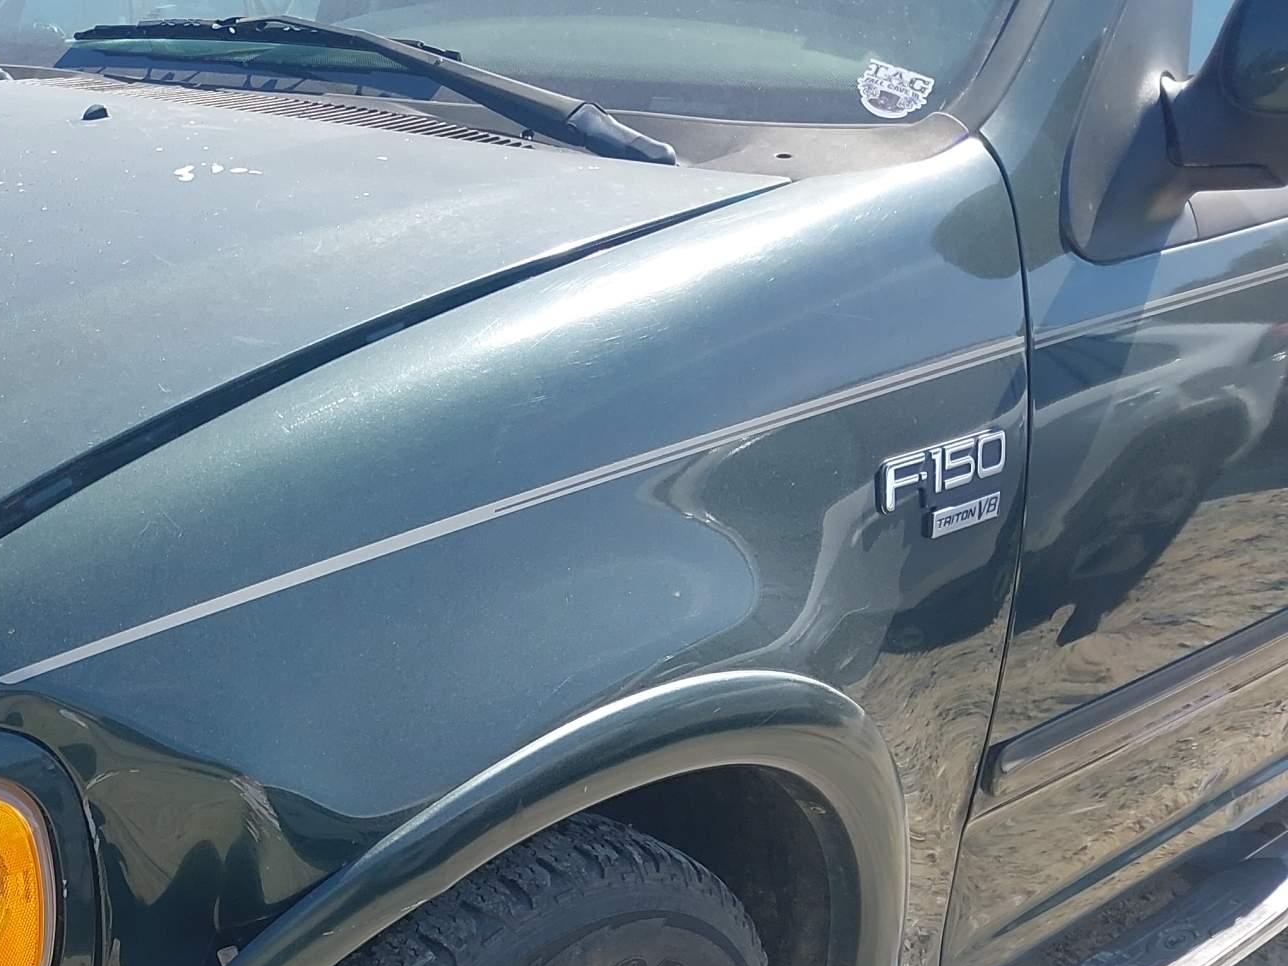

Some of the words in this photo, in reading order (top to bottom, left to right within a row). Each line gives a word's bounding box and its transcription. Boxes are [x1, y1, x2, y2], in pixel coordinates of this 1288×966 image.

[885, 430, 1007, 512] F-150
[936, 507, 976, 529] TRITON
[976, 496, 999, 521] V8
